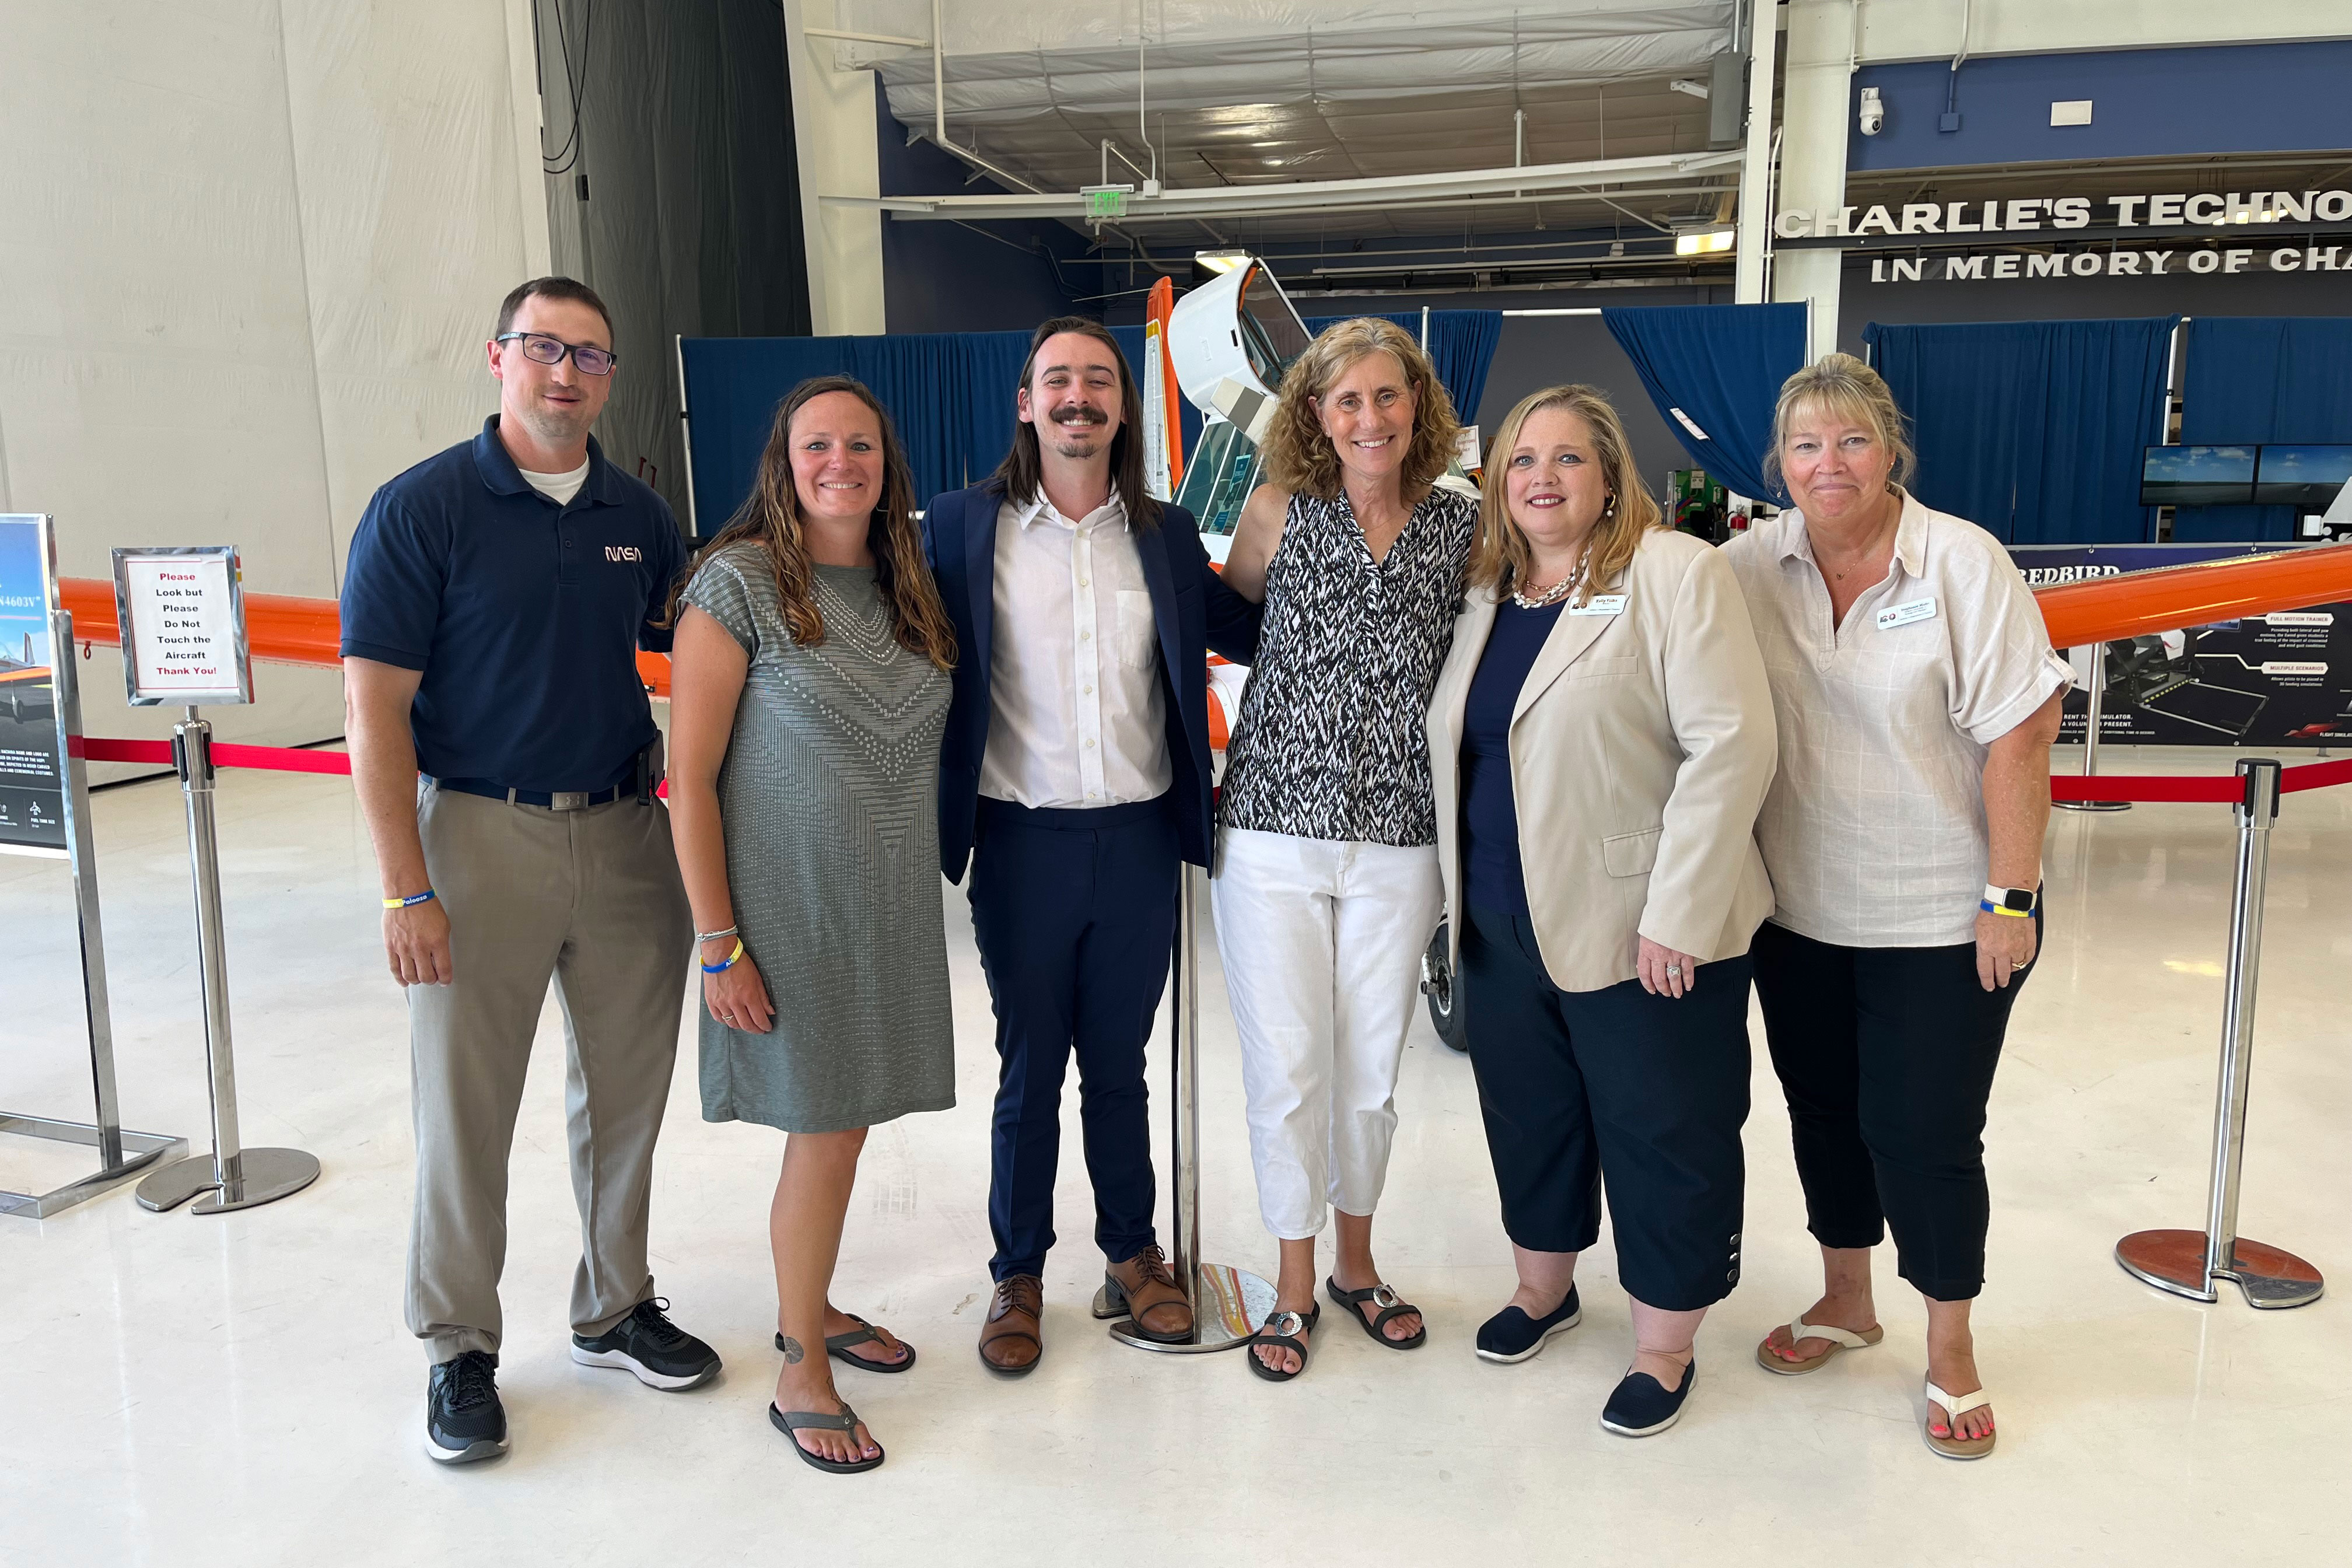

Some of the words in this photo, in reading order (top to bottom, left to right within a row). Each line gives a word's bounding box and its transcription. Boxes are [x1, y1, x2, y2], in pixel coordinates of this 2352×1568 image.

[1094, 192, 1119, 214] EXIT
[1774, 198, 2091, 238] CHARLIE'S
[1871, 258, 1927, 282] IN
[1945, 251, 2174, 280] MEMORY
[2189, 249, 2253, 274] OF
[605, 546, 642, 562] NASA
[402, 894, 428, 905] Palooza
